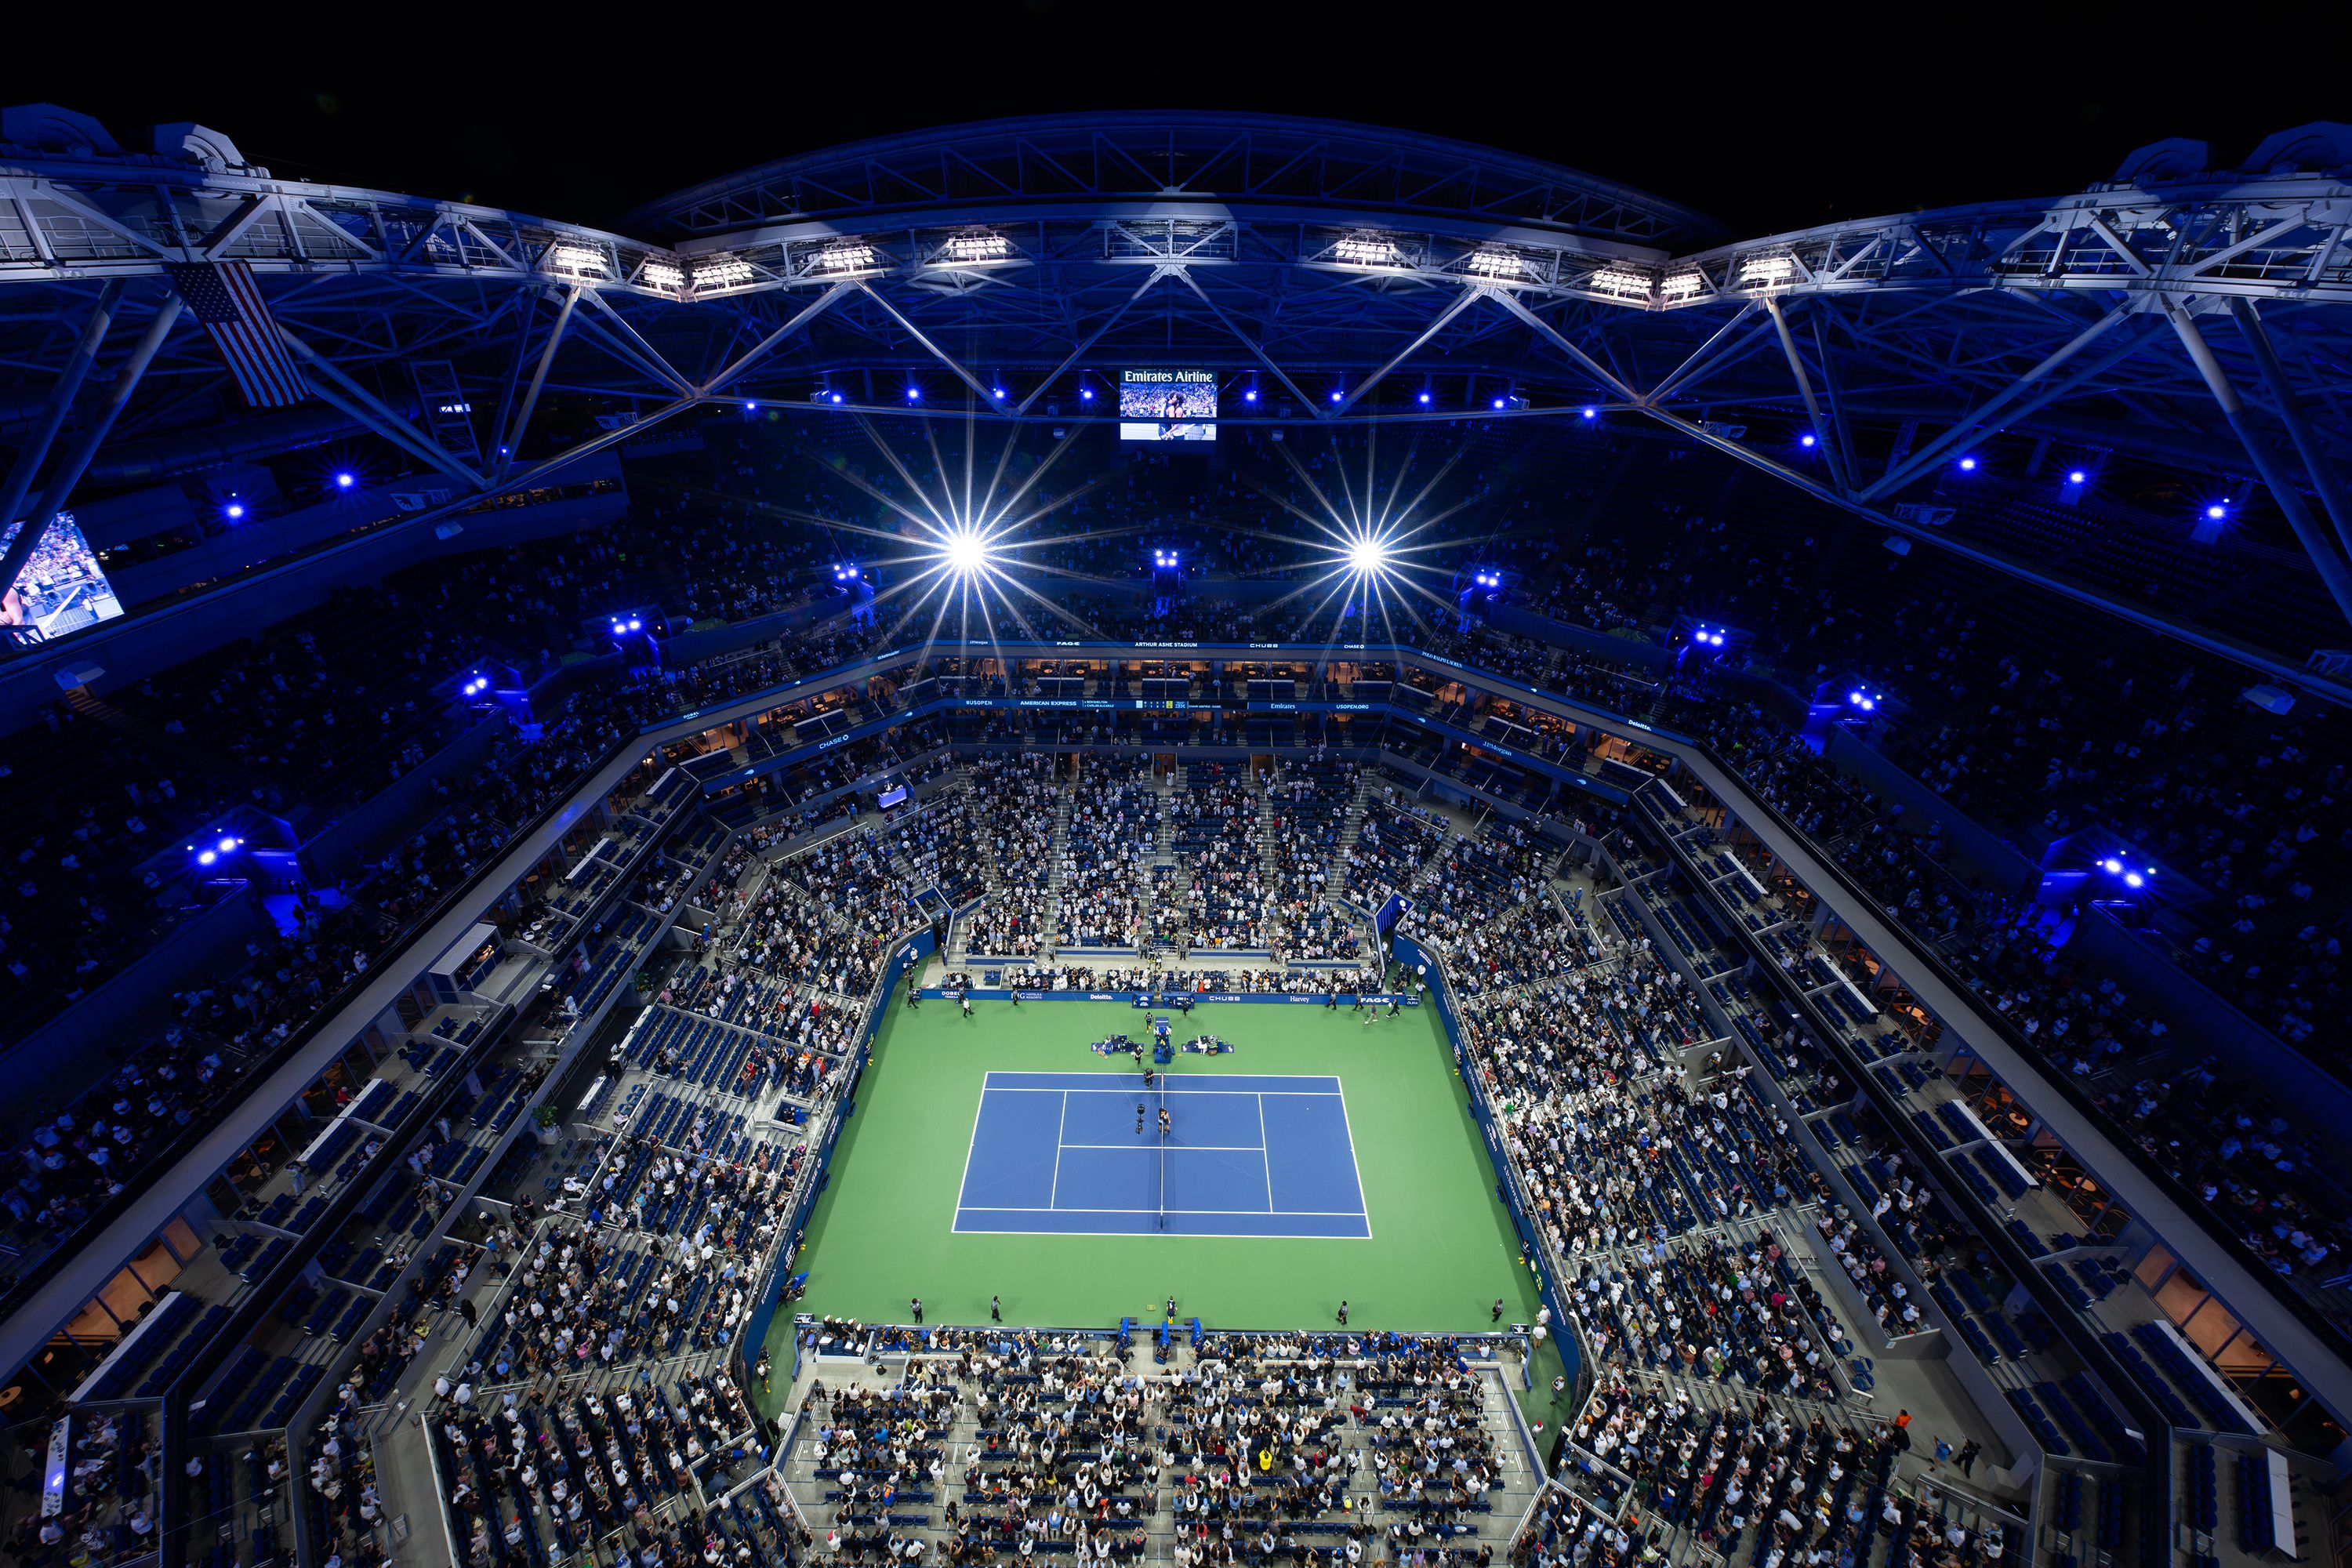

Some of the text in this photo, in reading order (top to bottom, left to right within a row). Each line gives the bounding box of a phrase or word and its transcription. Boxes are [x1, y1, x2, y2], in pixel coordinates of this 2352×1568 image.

[1124, 371, 1213, 383] Emirates Airline
[1628, 719, 1652, 731] Deloitte.
[818, 737, 842, 750] CHASE
[1482, 740, 1512, 757] J.P.Morgan
[844, 1066, 856, 1098] CHASE
[1467, 1064, 1483, 1106] J.P.Morgan
[803, 1167, 818, 1205] CHASE
[1503, 1165, 1523, 1216] J.P.Morgan
[1551, 1287, 1566, 1327] Emirates
